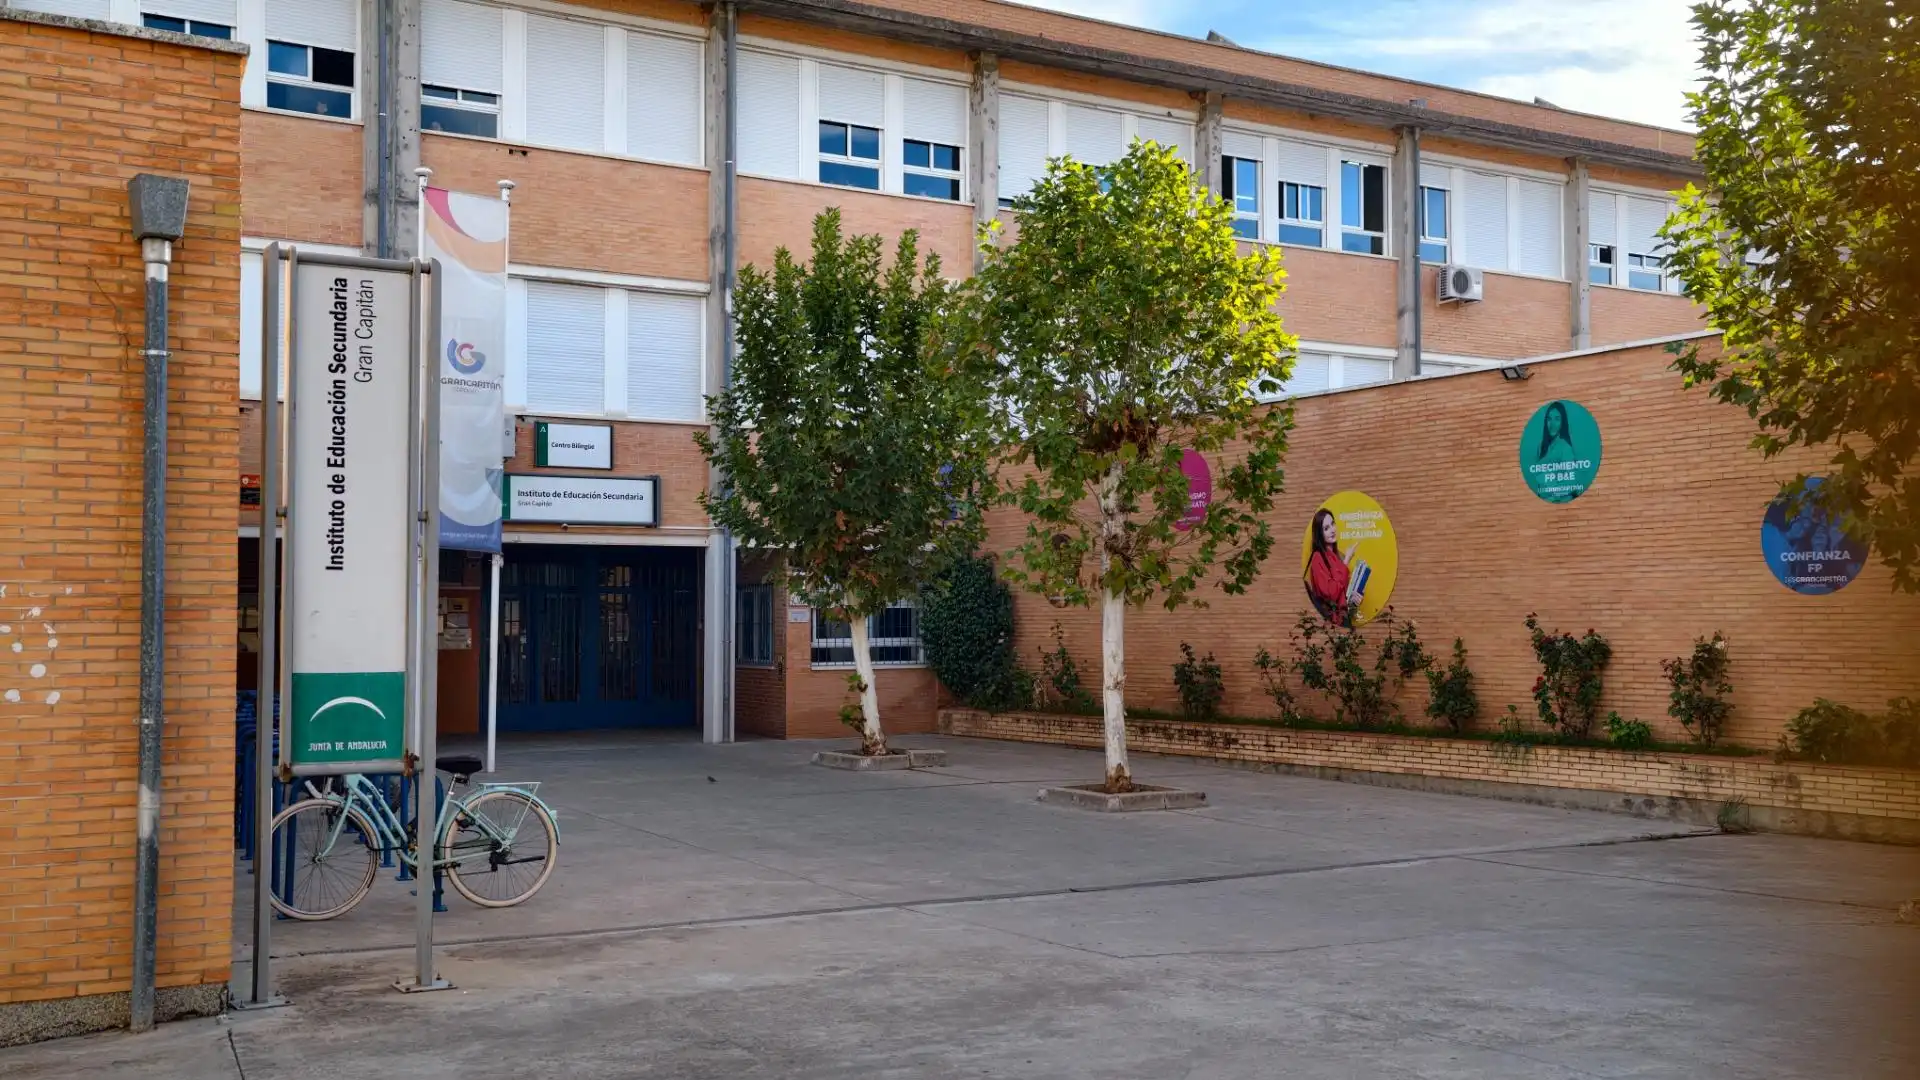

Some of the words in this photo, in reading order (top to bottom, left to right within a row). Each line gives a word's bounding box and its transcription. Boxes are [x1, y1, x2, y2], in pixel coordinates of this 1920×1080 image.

[354, 279, 377, 339] Capitán
[328, 276, 348, 374] Secundaria
[354, 345, 373, 383] Gran
[327, 379, 347, 469] Educación
[551, 441, 571, 449] Centro
[571, 442, 595, 451] Bilingüe
[1529, 460, 1591, 473] CRECIMIENTO
[327, 473, 346, 495] de
[1544, 473, 1556, 483] FP
[1557, 472, 1576, 482] B&E
[517, 489, 551, 498] Instituto
[552, 491, 562, 499] de
[563, 491, 601, 500] Educación
[602, 492, 644, 501] Secundaria
[325, 498, 346, 571] Instituto
[1780, 550, 1852, 562] CONFIANZA
[1807, 563, 1823, 573] FP
[308, 742, 332, 752] JUNTA
[335, 742, 345, 751] DE
